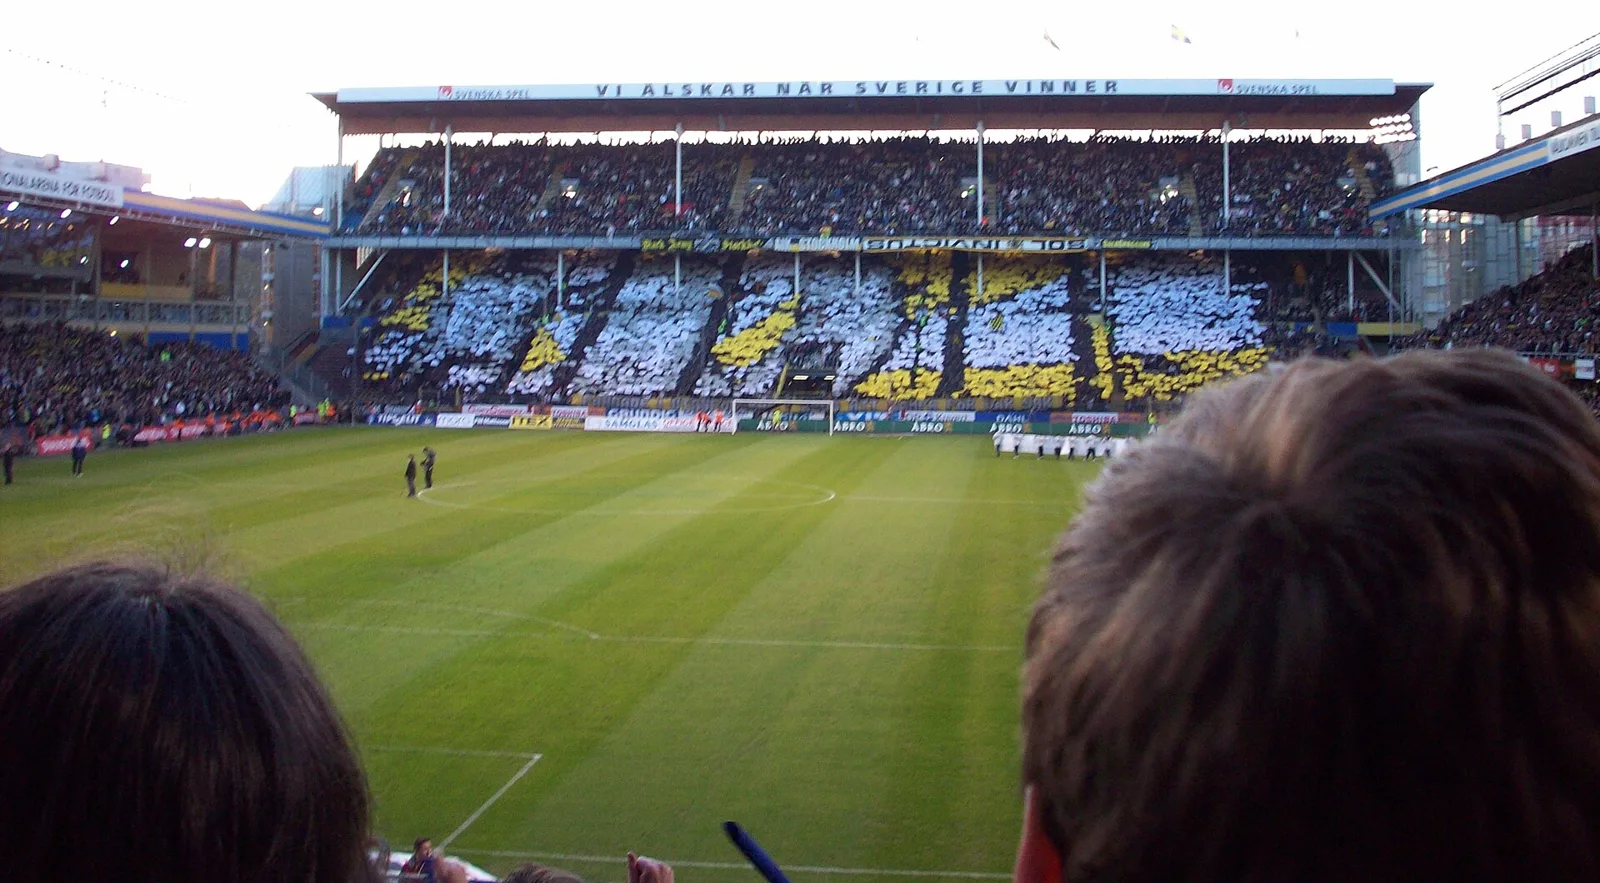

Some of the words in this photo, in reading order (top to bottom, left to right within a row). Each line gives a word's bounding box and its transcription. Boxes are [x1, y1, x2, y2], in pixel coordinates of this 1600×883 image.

[454, 89, 503, 100] SVENSKA
[506, 88, 531, 99] SPEL
[597, 83, 622, 97] VI
[642, 82, 755, 97] ÄLSKAR
[777, 81, 833, 96] NÄR
[855, 80, 983, 95] SVERIGE
[1004, 79, 1119, 94] VINNER
[1235, 83, 1287, 95] SVENSKA
[1291, 83, 1319, 95] SPEL
